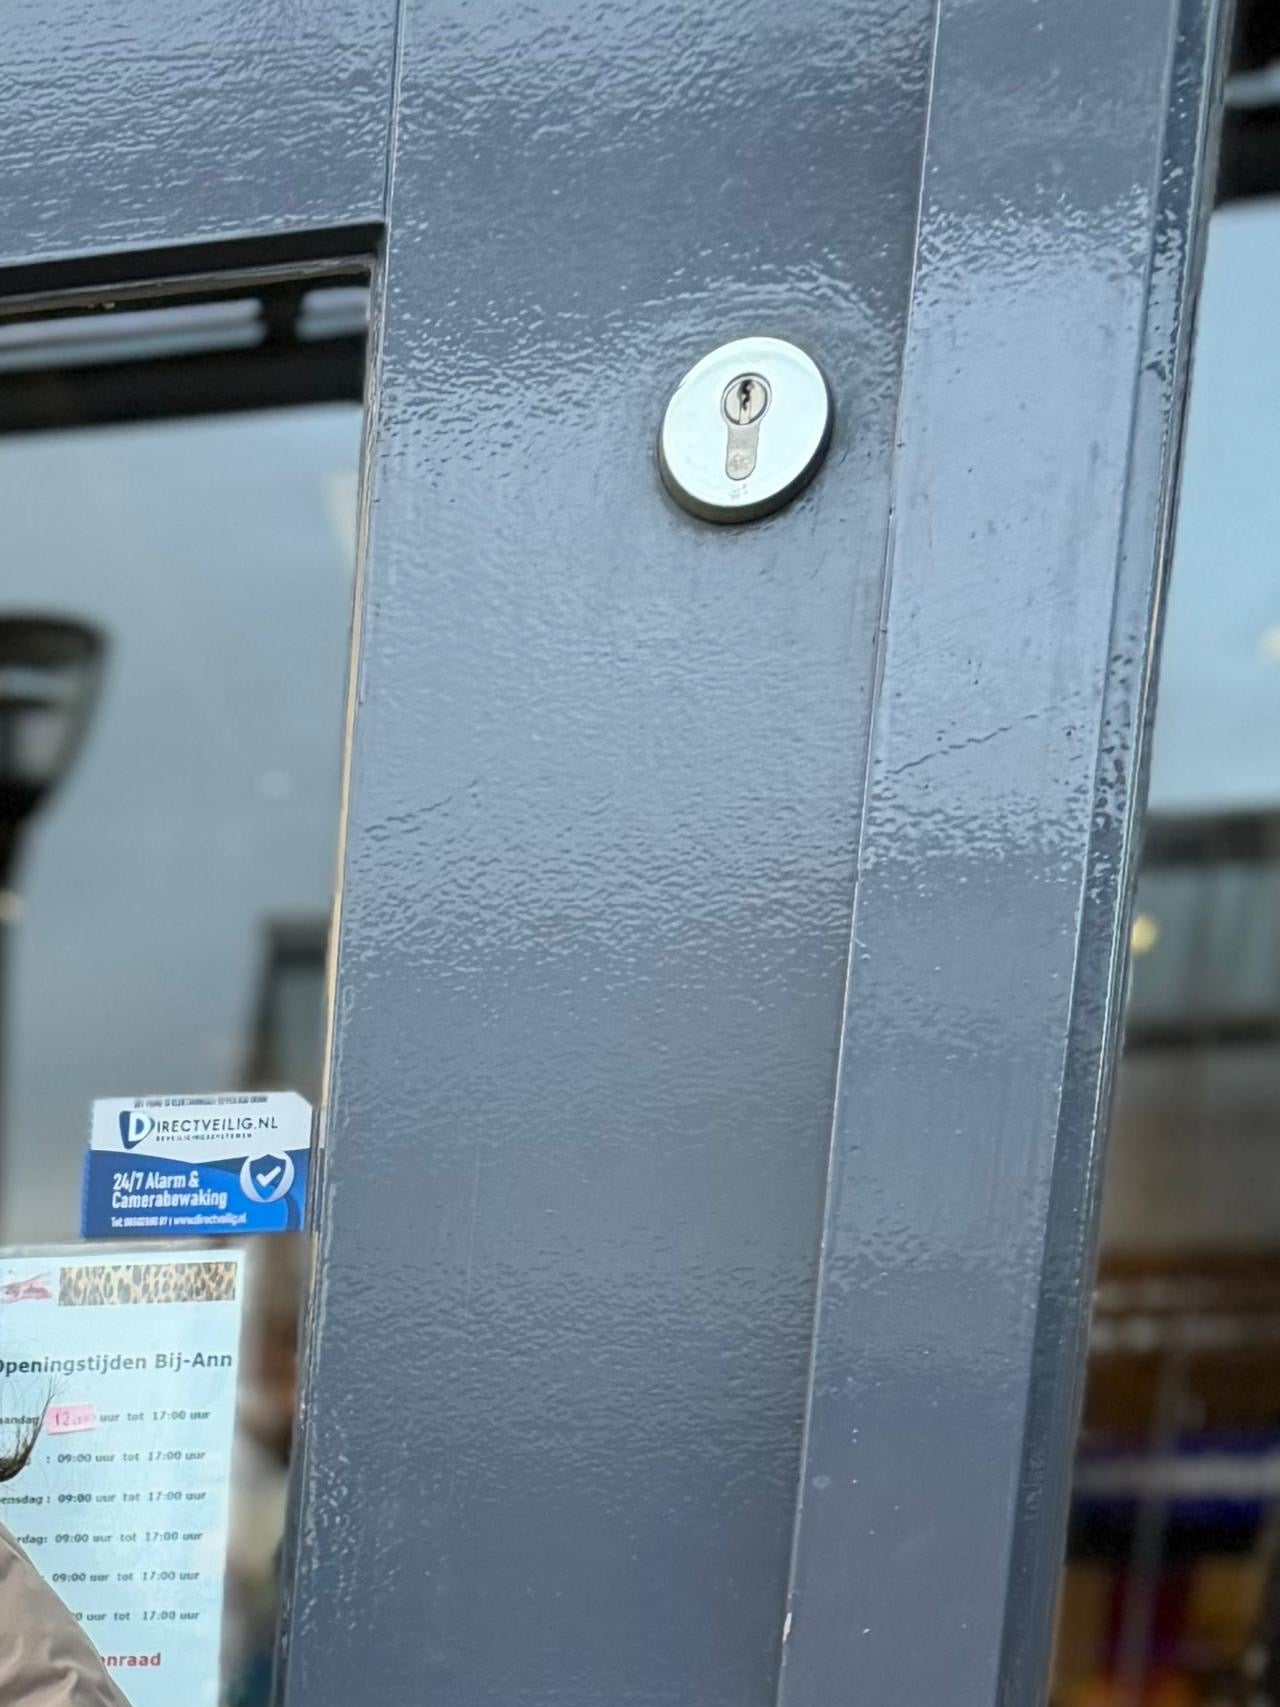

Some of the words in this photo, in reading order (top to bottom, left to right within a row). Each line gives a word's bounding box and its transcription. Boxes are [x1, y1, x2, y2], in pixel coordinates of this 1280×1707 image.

[113, 1171, 142, 1193] 24/7
[145, 1173, 186, 1190] Alarm
[188, 1171, 200, 1188] &
[111, 1190, 228, 1210] Camerabewaking
[155, 1352, 233, 1373] Bij-Ann
[100, 1413, 120, 1423] uur
[127, 1411, 145, 1422] tot
[152, 1410, 187, 1421] 17:00
[190, 1409, 211, 1420] uur
[57, 1454, 92, 1464] 09:00
[95, 1454, 116, 1463] uur
[123, 1452, 140, 1462] tot
[147, 1451, 182, 1462] 17:00
[185, 1450, 207, 1460] uur
[57, 1493, 92, 1504] 09:00
[95, 1493, 116, 1503] uur
[123, 1492, 141, 1502] tot
[147, 1490, 182, 1501] 17:00
[185, 1490, 207, 1500] uur
[14, 1533, 48, 1545] rdag:
[54, 1532, 89, 1544] 09:00
[92, 1532, 113, 1542] uur
[119, 1532, 138, 1542] tot
[145, 1530, 180, 1542] 17:00
[182, 1530, 204, 1541] uur
[51, 1571, 87, 1583] 09:00
[89, 1571, 110, 1582] uur
[116, 1571, 134, 1582] tot
[142, 1570, 177, 1581] 17:00
[179, 1570, 201, 1580] uur
[86, 1611, 107, 1622] uur
[113, 1610, 131, 1621] tot
[142, 1609, 177, 1621] 17:00
[179, 1609, 201, 1620] uur
